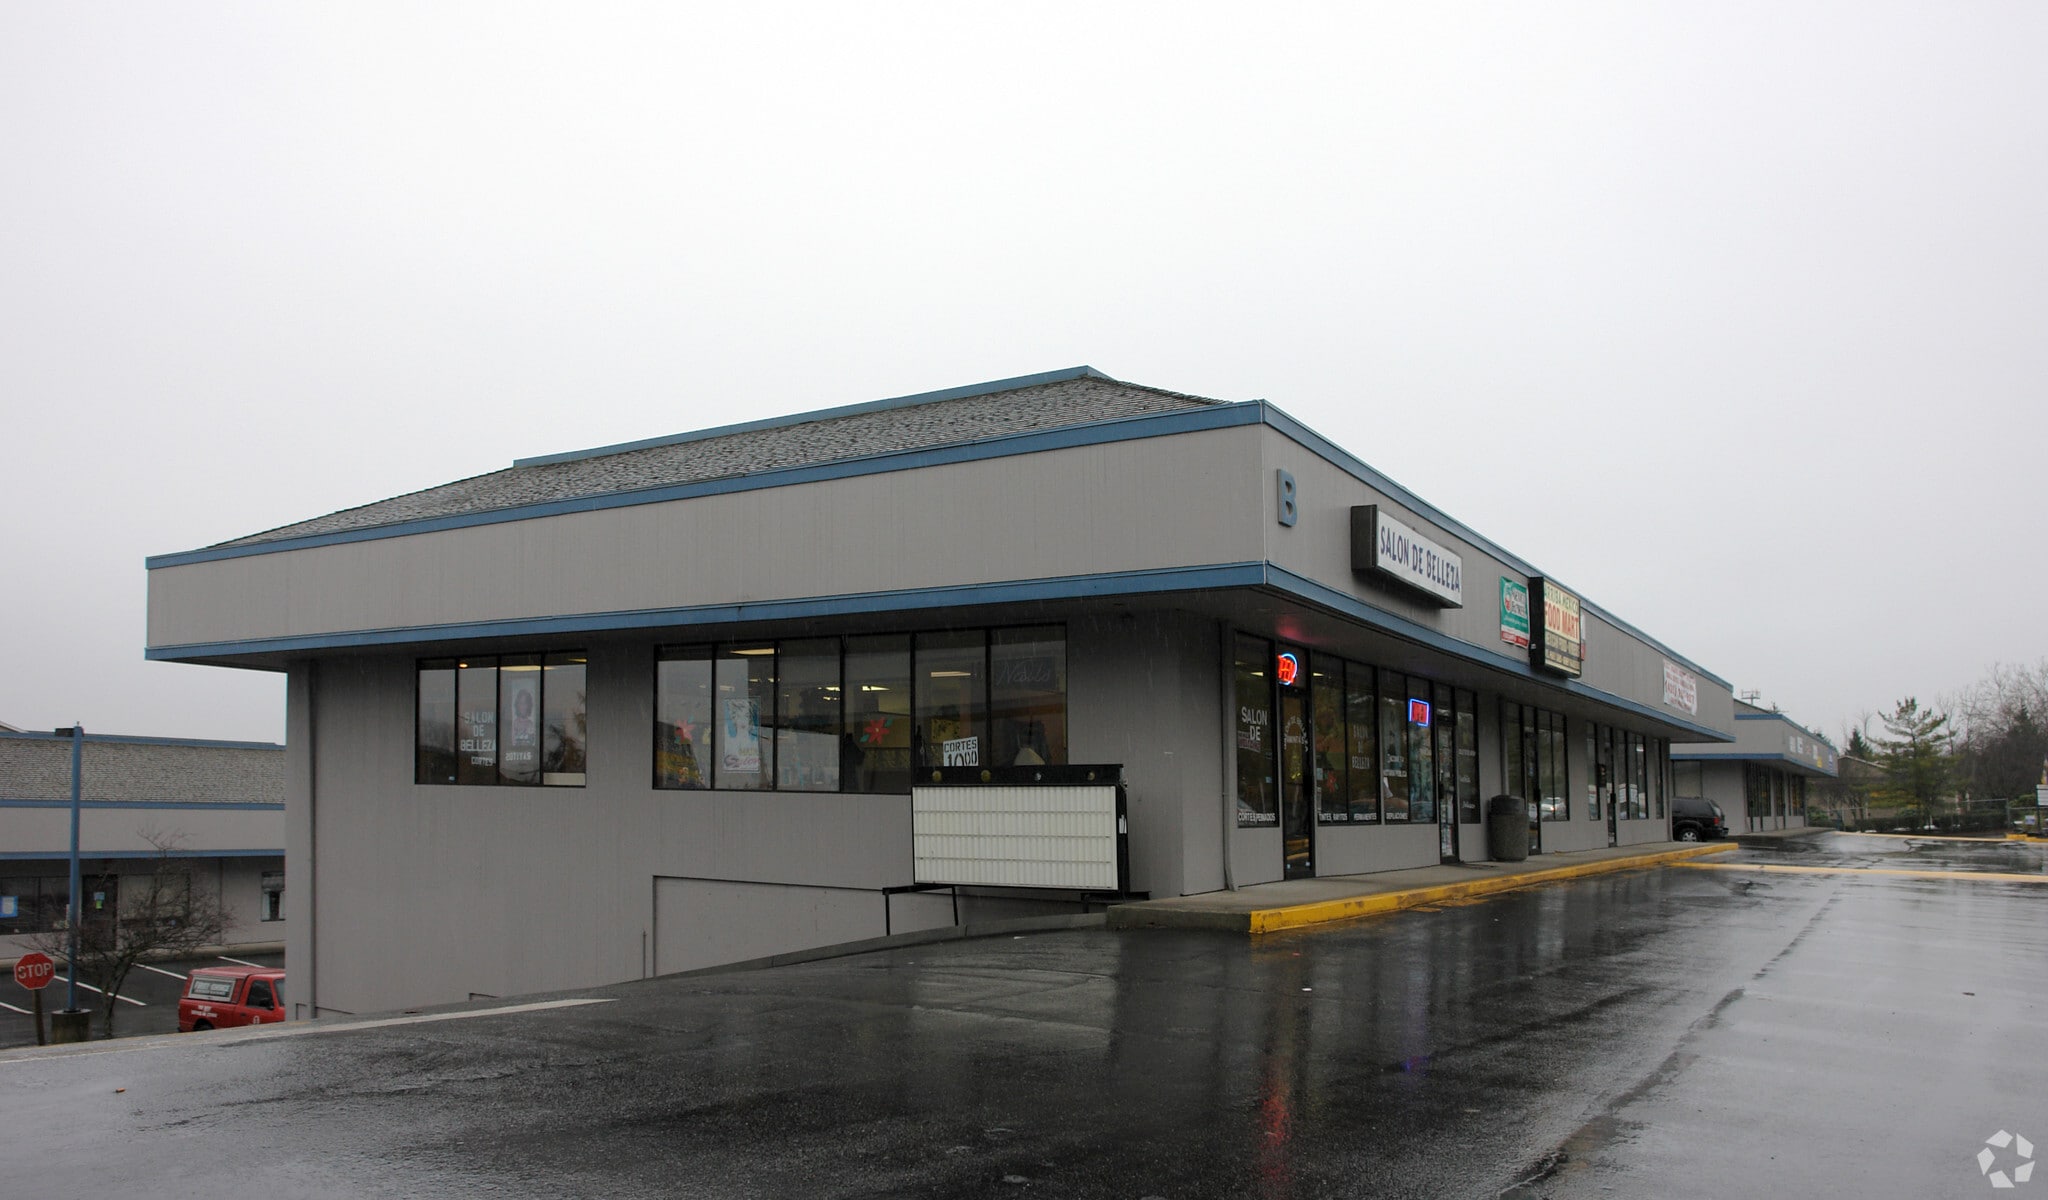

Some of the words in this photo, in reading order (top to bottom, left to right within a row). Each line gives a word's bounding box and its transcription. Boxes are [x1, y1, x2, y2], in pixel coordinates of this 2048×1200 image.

[1277, 469, 1297, 527] B
[1380, 526, 1409, 567] SALON
[1412, 544, 1423, 574] DE
[1426, 550, 1460, 592] BELLEZA
[1545, 601, 1561, 631] FOOD
[1562, 610, 1579, 640] MART
[464, 711, 494, 724] SALON
[1241, 706, 1267, 726] SALON
[473, 724, 485, 737] DE
[1250, 725, 1261, 741] DE
[460, 739, 496, 752] BELLEZA
[944, 739, 976, 753] CORTES
[18, 962, 52, 979] STOP
